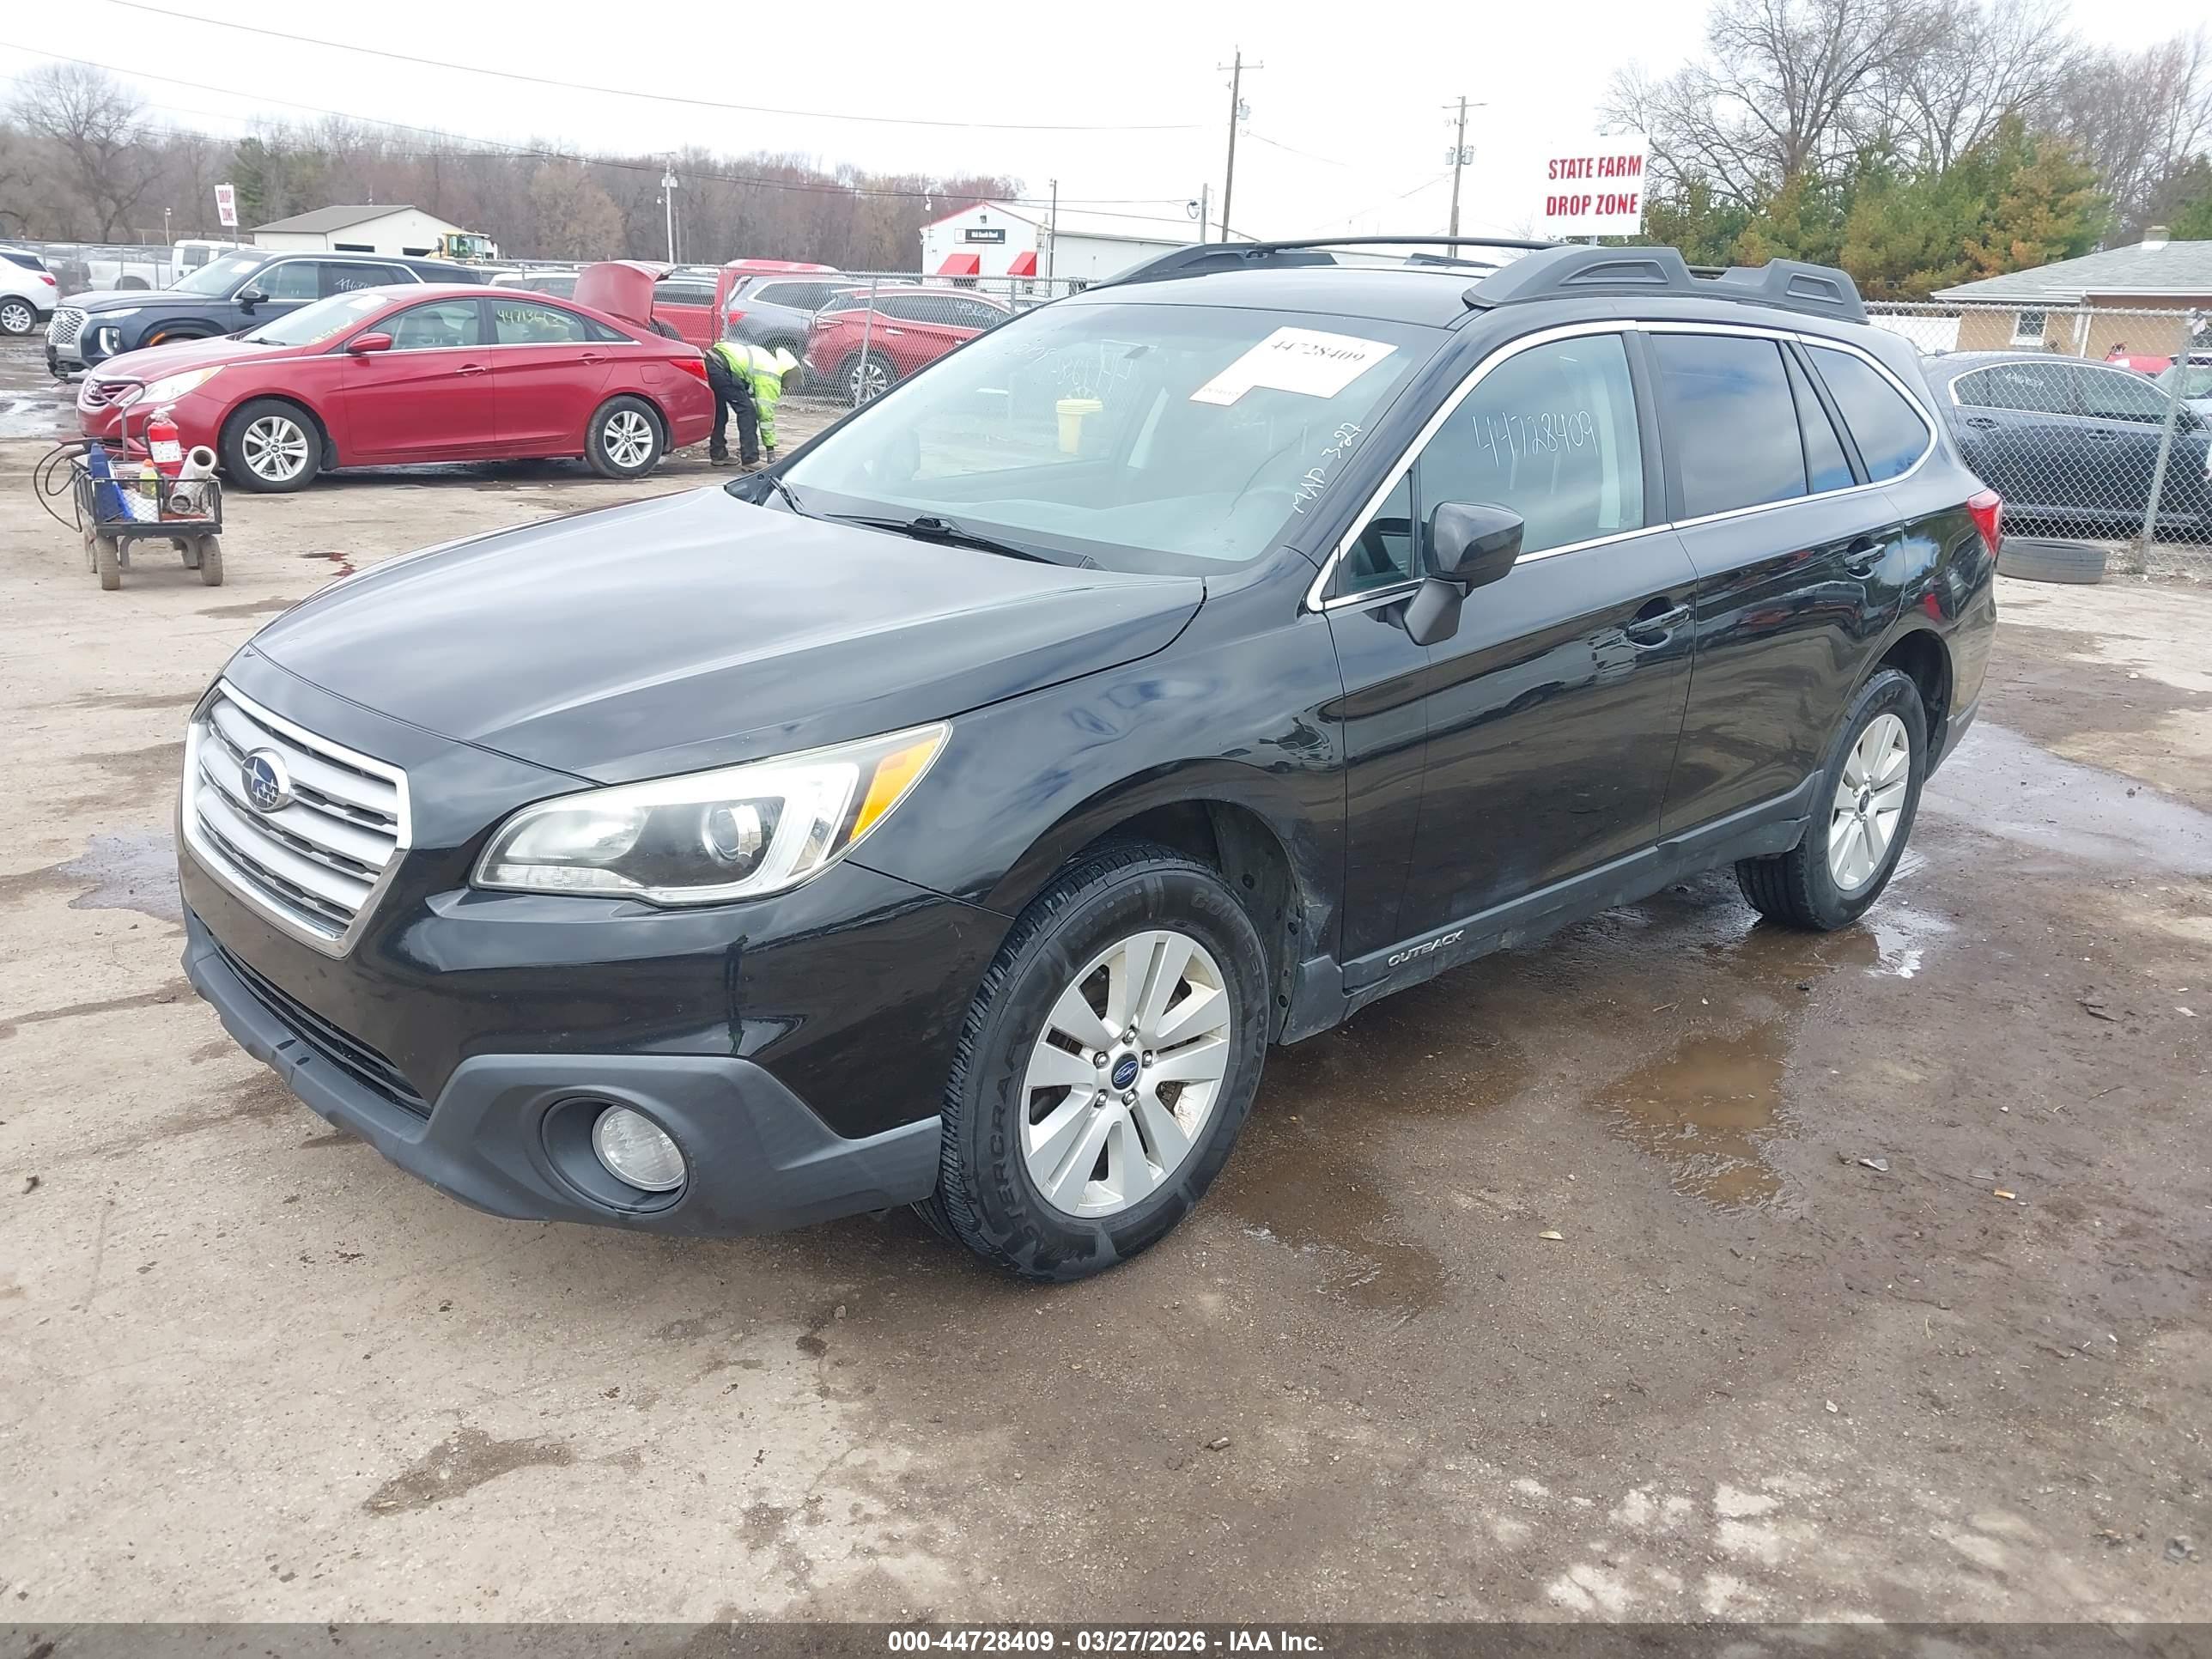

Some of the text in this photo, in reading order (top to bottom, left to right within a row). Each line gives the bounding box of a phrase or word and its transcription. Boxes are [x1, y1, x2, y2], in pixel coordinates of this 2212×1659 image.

[1548, 155, 1642, 180] STATE FARM
[1546, 192, 1639, 216] DROP ZONE
[1472, 410, 1599, 468] 44728409
[1388, 929, 1465, 967] OUTBACK
